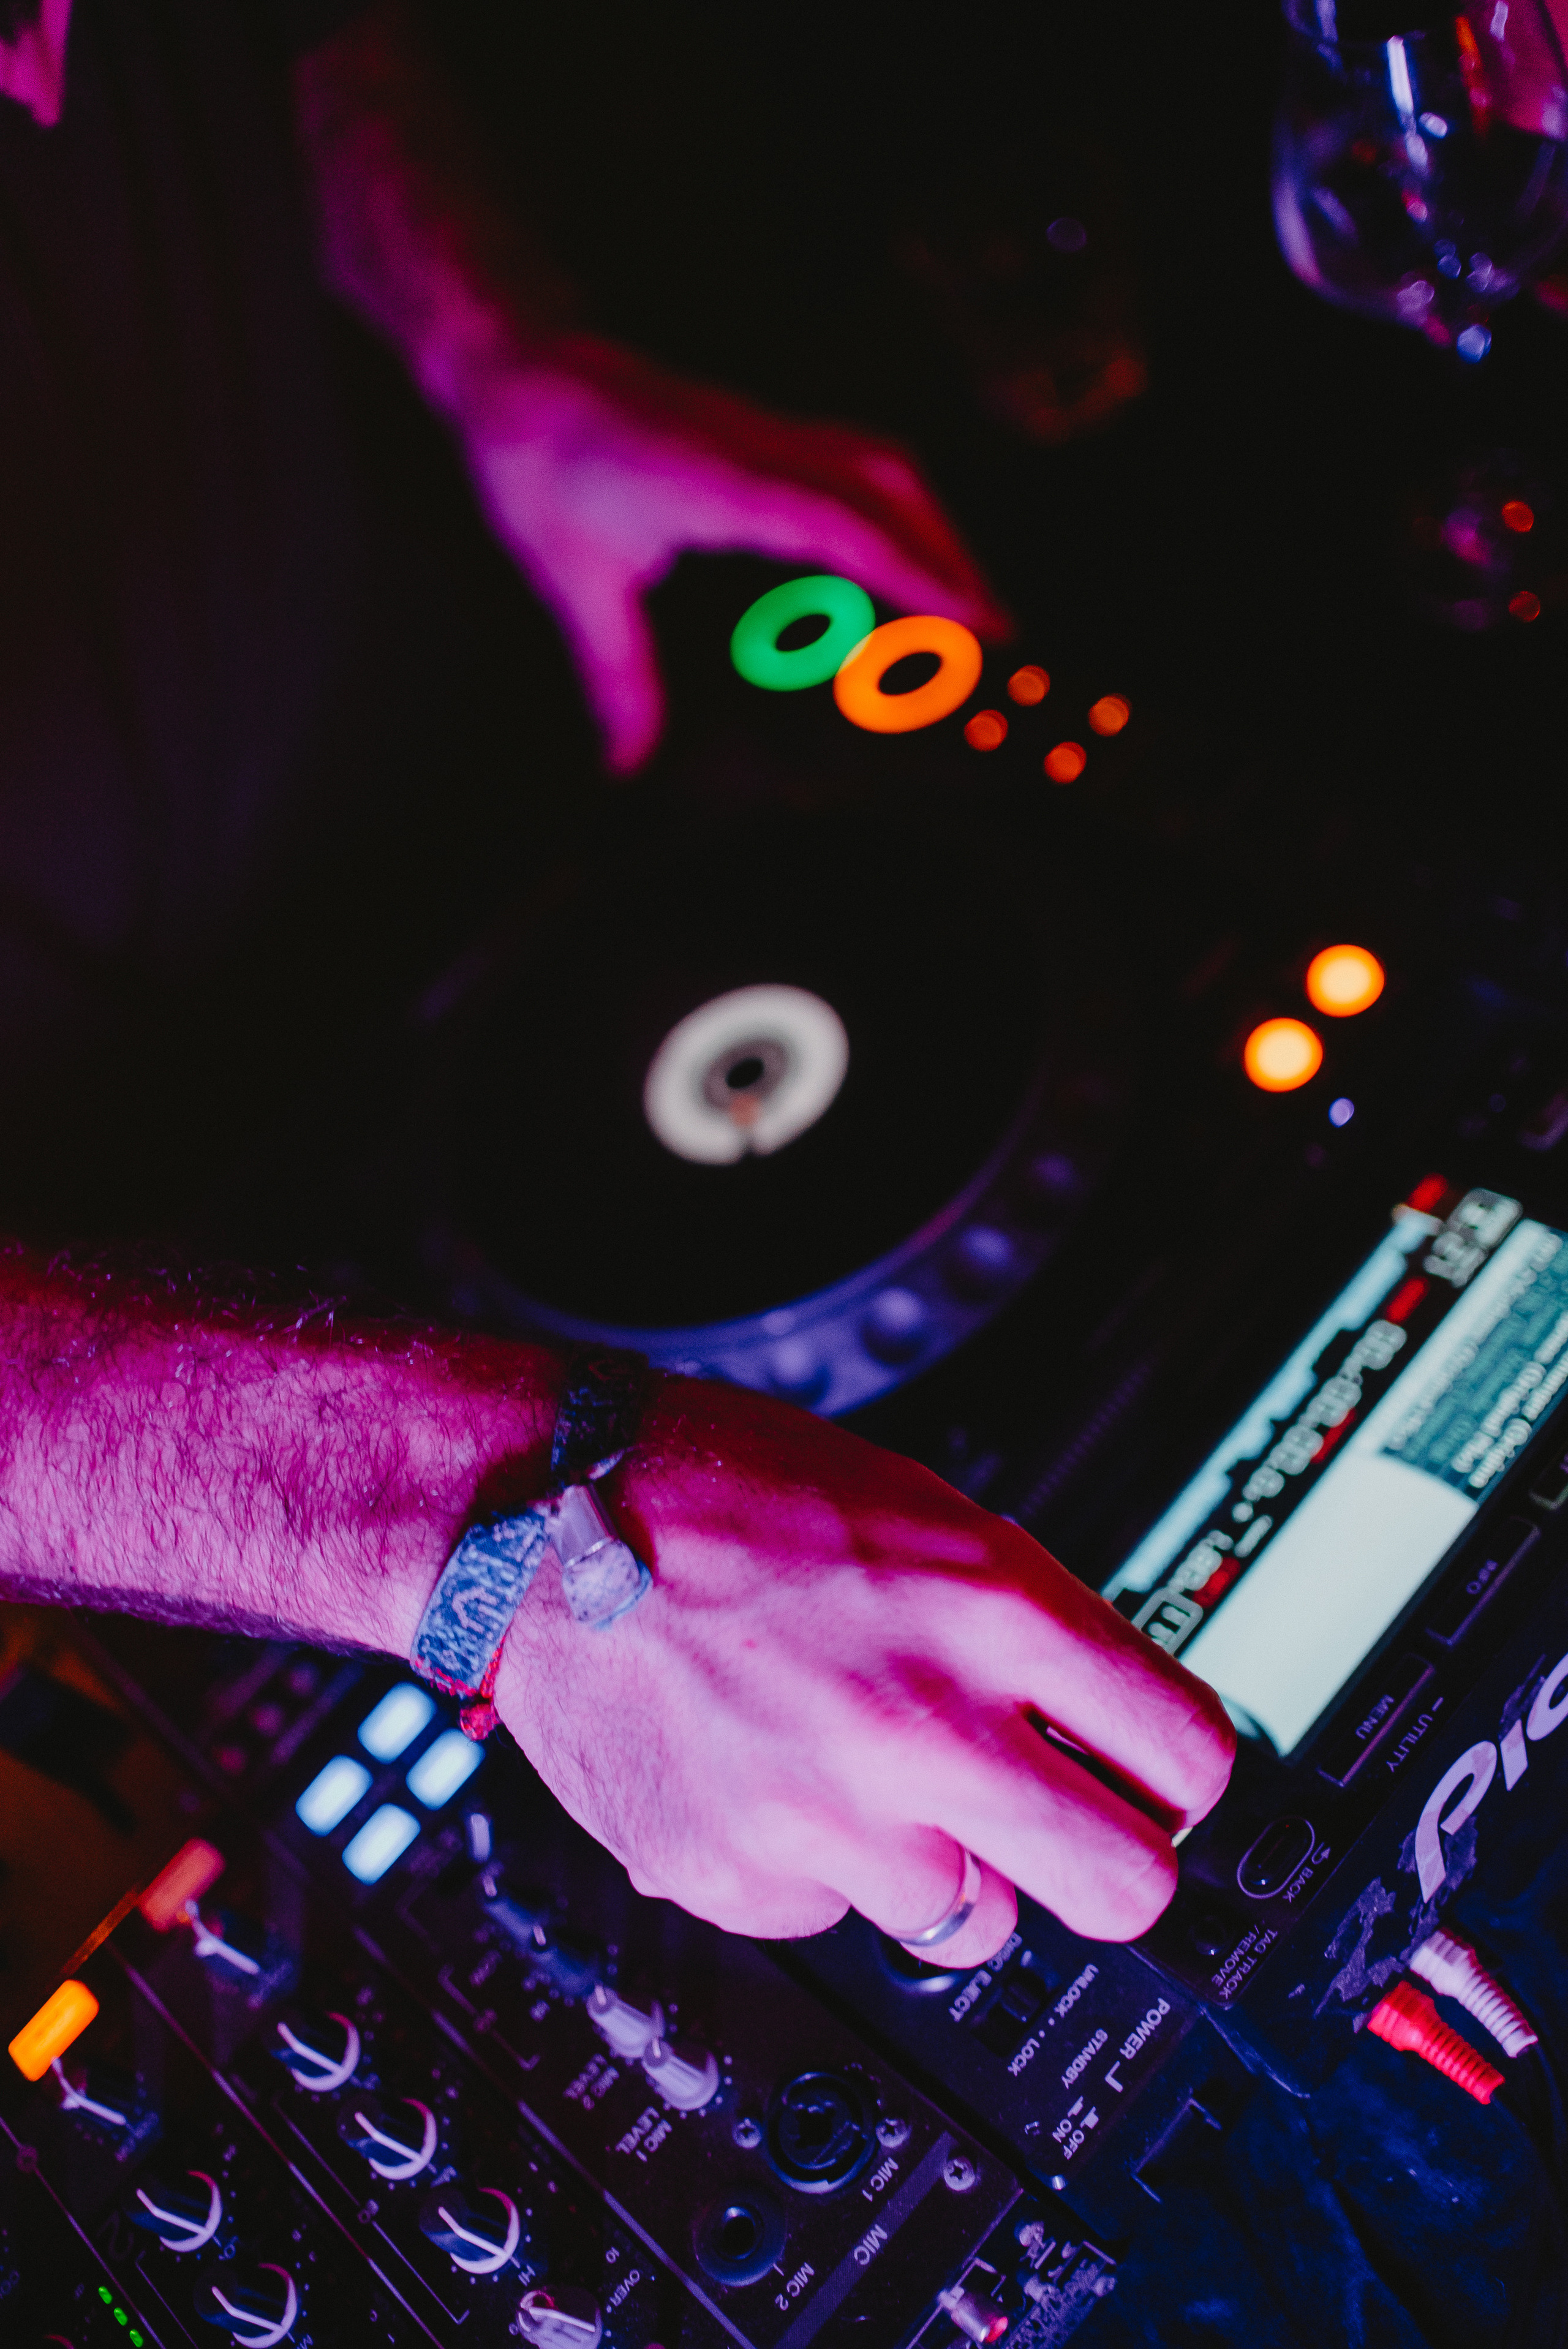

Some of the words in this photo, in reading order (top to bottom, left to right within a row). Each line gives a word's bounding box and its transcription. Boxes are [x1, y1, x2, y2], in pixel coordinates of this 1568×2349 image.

[1355, 1694, 1395, 1740] MENU
[1386, 1714, 1433, 1773] UTILITY
[1283, 1866, 1313, 1903] BACK
[1252, 1926, 1279, 1956] TAG
[1054, 1964, 1099, 2018] UNLOCK
[1217, 1953, 1257, 2000] TRACK
[949, 1969, 992, 2022] EJECT
[1120, 1997, 1171, 2059] POWER
[1008, 2037, 1040, 2076] LOCK
[1061, 2028, 1108, 2089] STANDBY
[616, 2106, 660, 2154] LEVEL
[644, 2119, 672, 2152] MIC
[1052, 2119, 1072, 2143] ON
[1063, 2129, 1085, 2160] OFF
[870, 2157, 899, 2191] MIC
[861, 2189, 873, 2201] 1
[605, 2247, 620, 2263] 10
[854, 2224, 888, 2265] MIC
[518, 2265, 536, 2286] HI
[609, 2269, 640, 2307] OVER
[786, 2262, 815, 2297] MIC
[775, 2293, 789, 2310] 2
